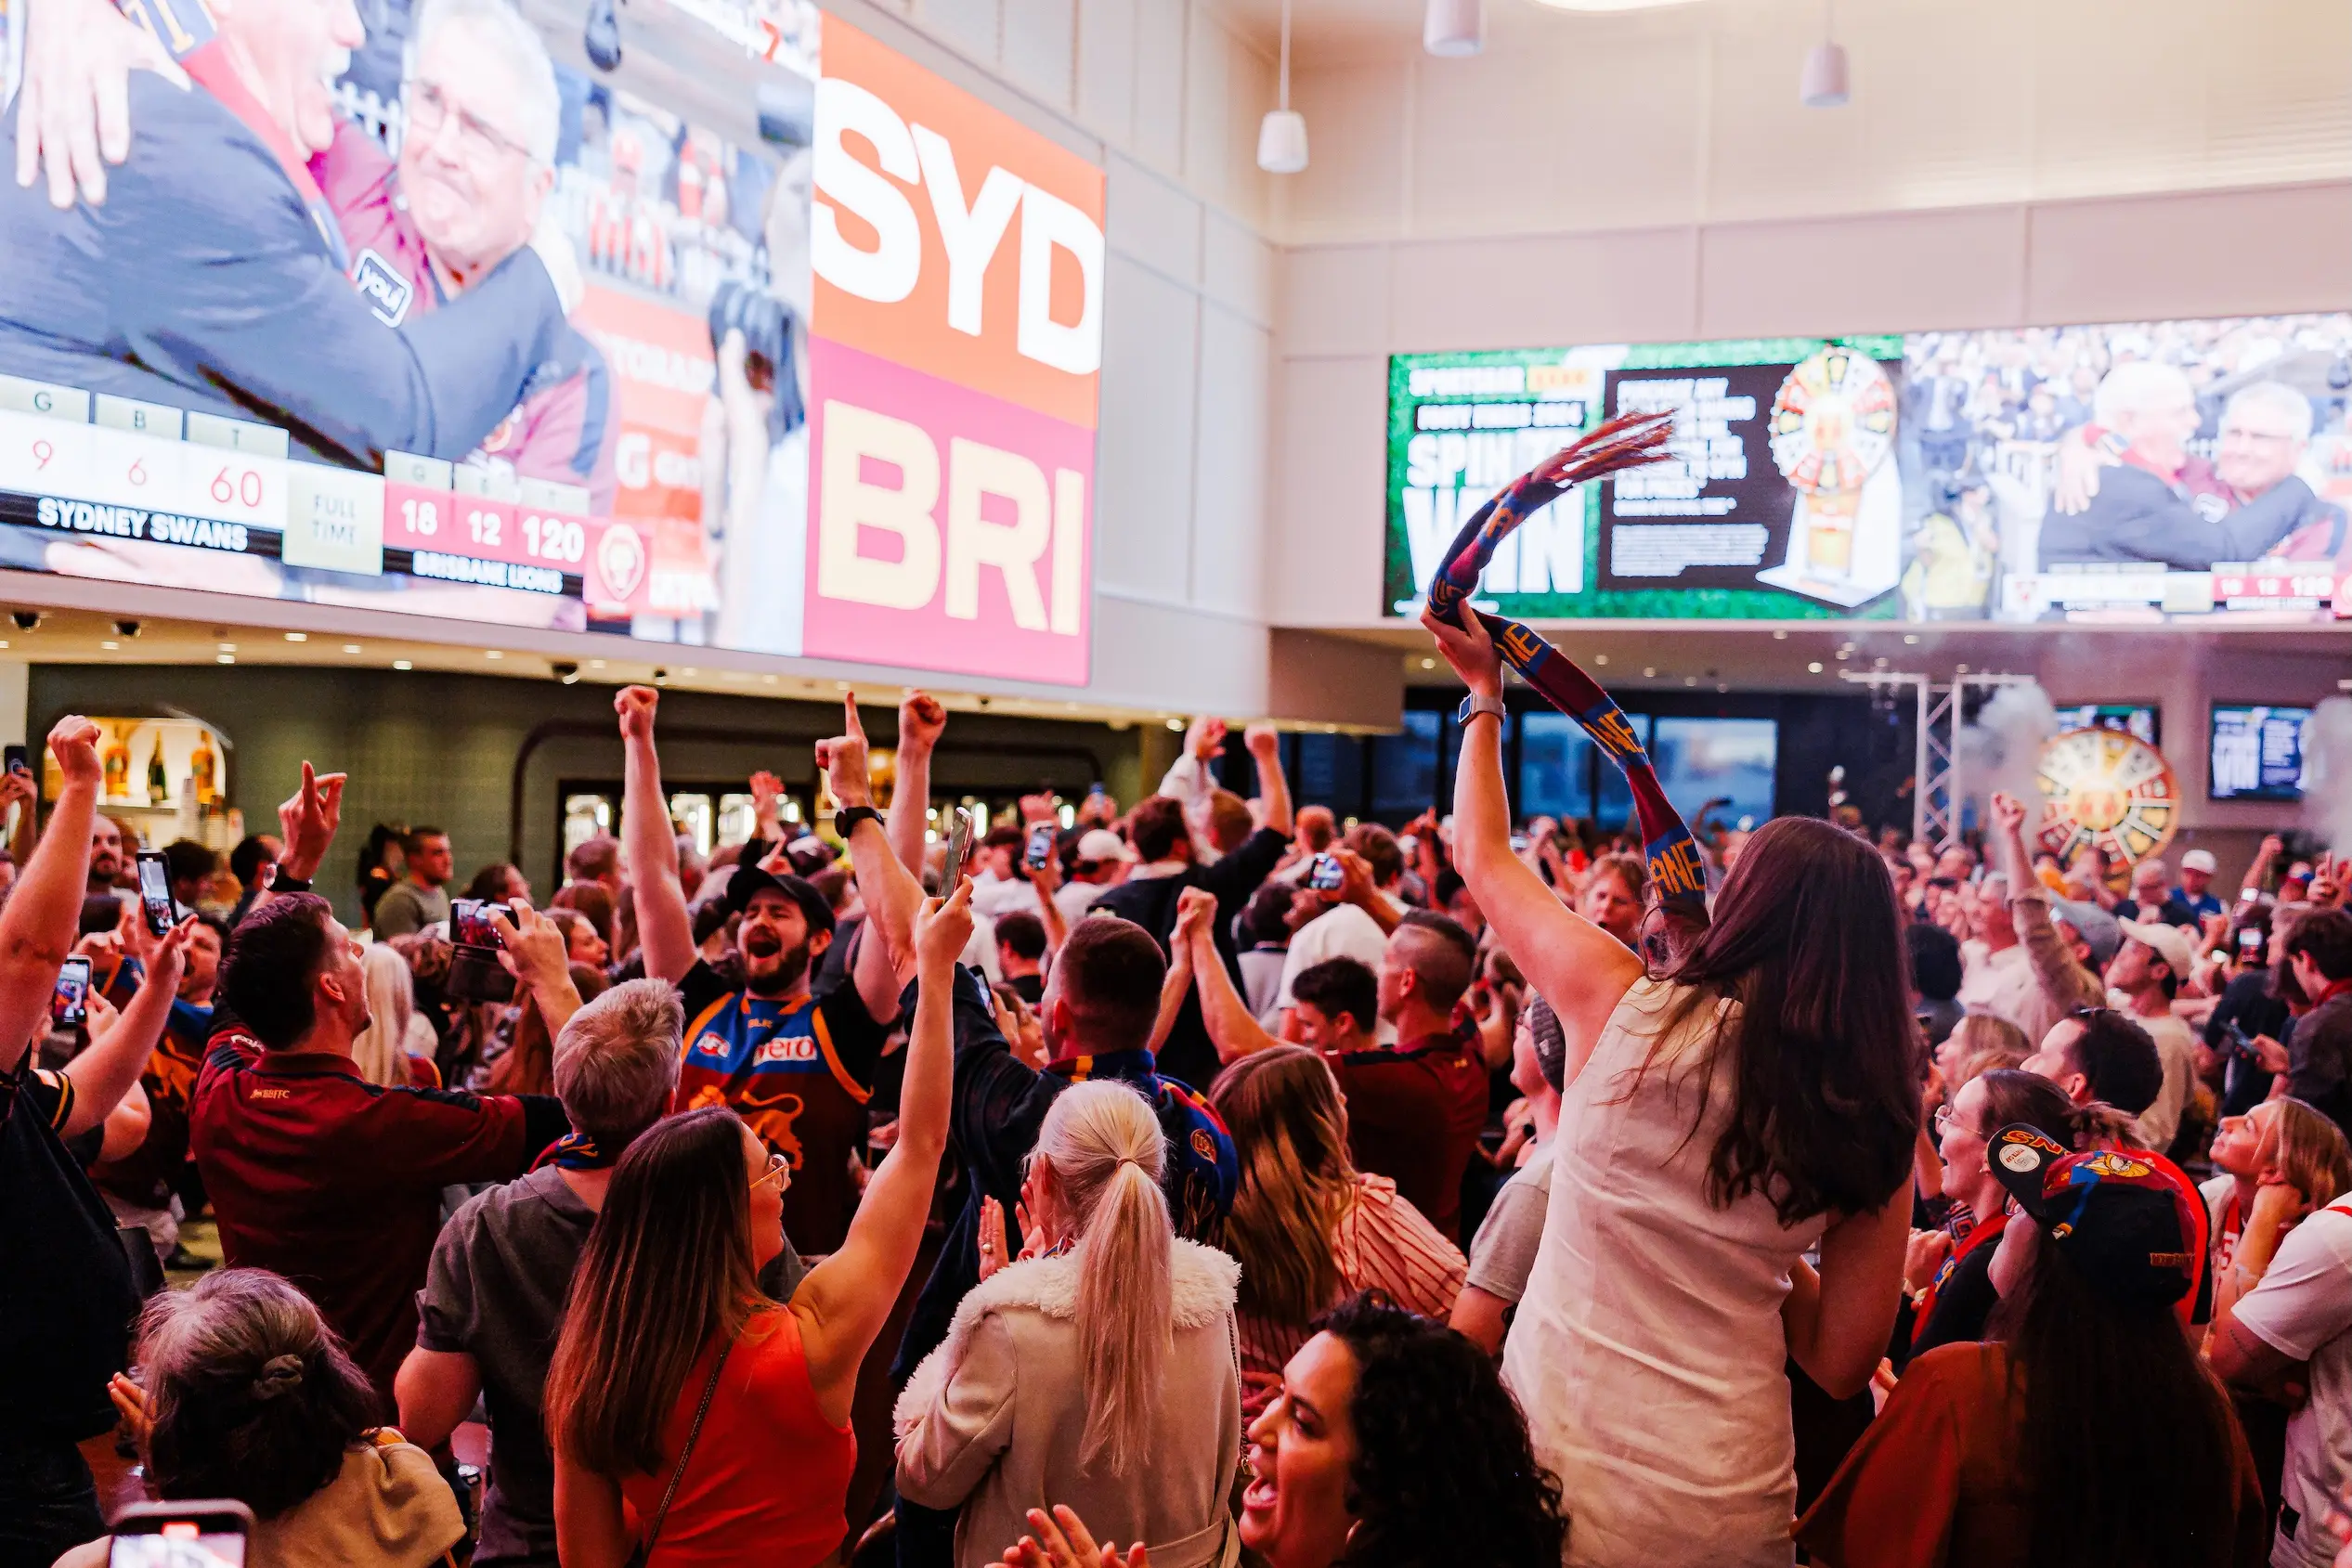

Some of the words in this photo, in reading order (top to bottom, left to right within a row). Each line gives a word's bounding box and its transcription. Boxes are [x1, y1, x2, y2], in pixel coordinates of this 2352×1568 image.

[811, 77, 1106, 376] SYD
[34, 391, 52, 411] G
[134, 409, 146, 430] B
[32, 440, 53, 471] 9
[128, 458, 147, 486] 6
[1406, 432, 1515, 488] SPIN
[211, 457, 262, 508] 60
[37, 497, 149, 539] SYDNEY
[149, 512, 249, 552] SWANS
[313, 493, 357, 520] FULL
[401, 499, 438, 537] 18
[817, 398, 1085, 636] BRI
[311, 519, 357, 547] TIME
[468, 510, 502, 547] 12
[522, 514, 586, 564] 120
